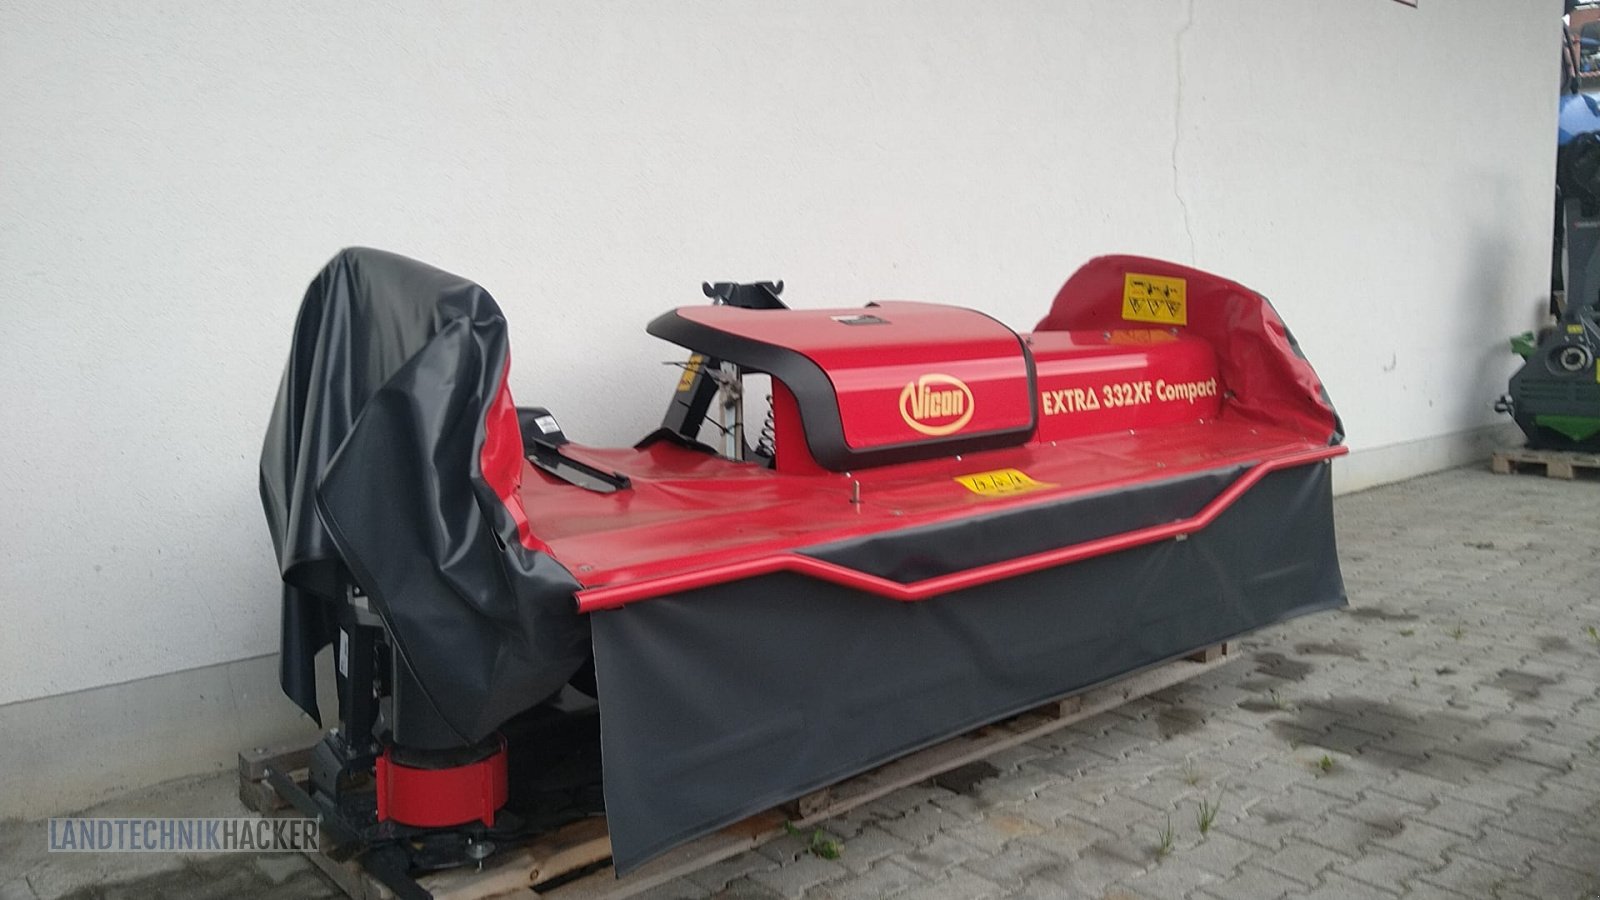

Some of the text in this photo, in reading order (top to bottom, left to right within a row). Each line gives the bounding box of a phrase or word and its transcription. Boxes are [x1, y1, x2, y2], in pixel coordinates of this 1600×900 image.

[908, 381, 964, 419] Vicon
[1103, 381, 1153, 408] 332XF
[1155, 377, 1217, 404] Compact
